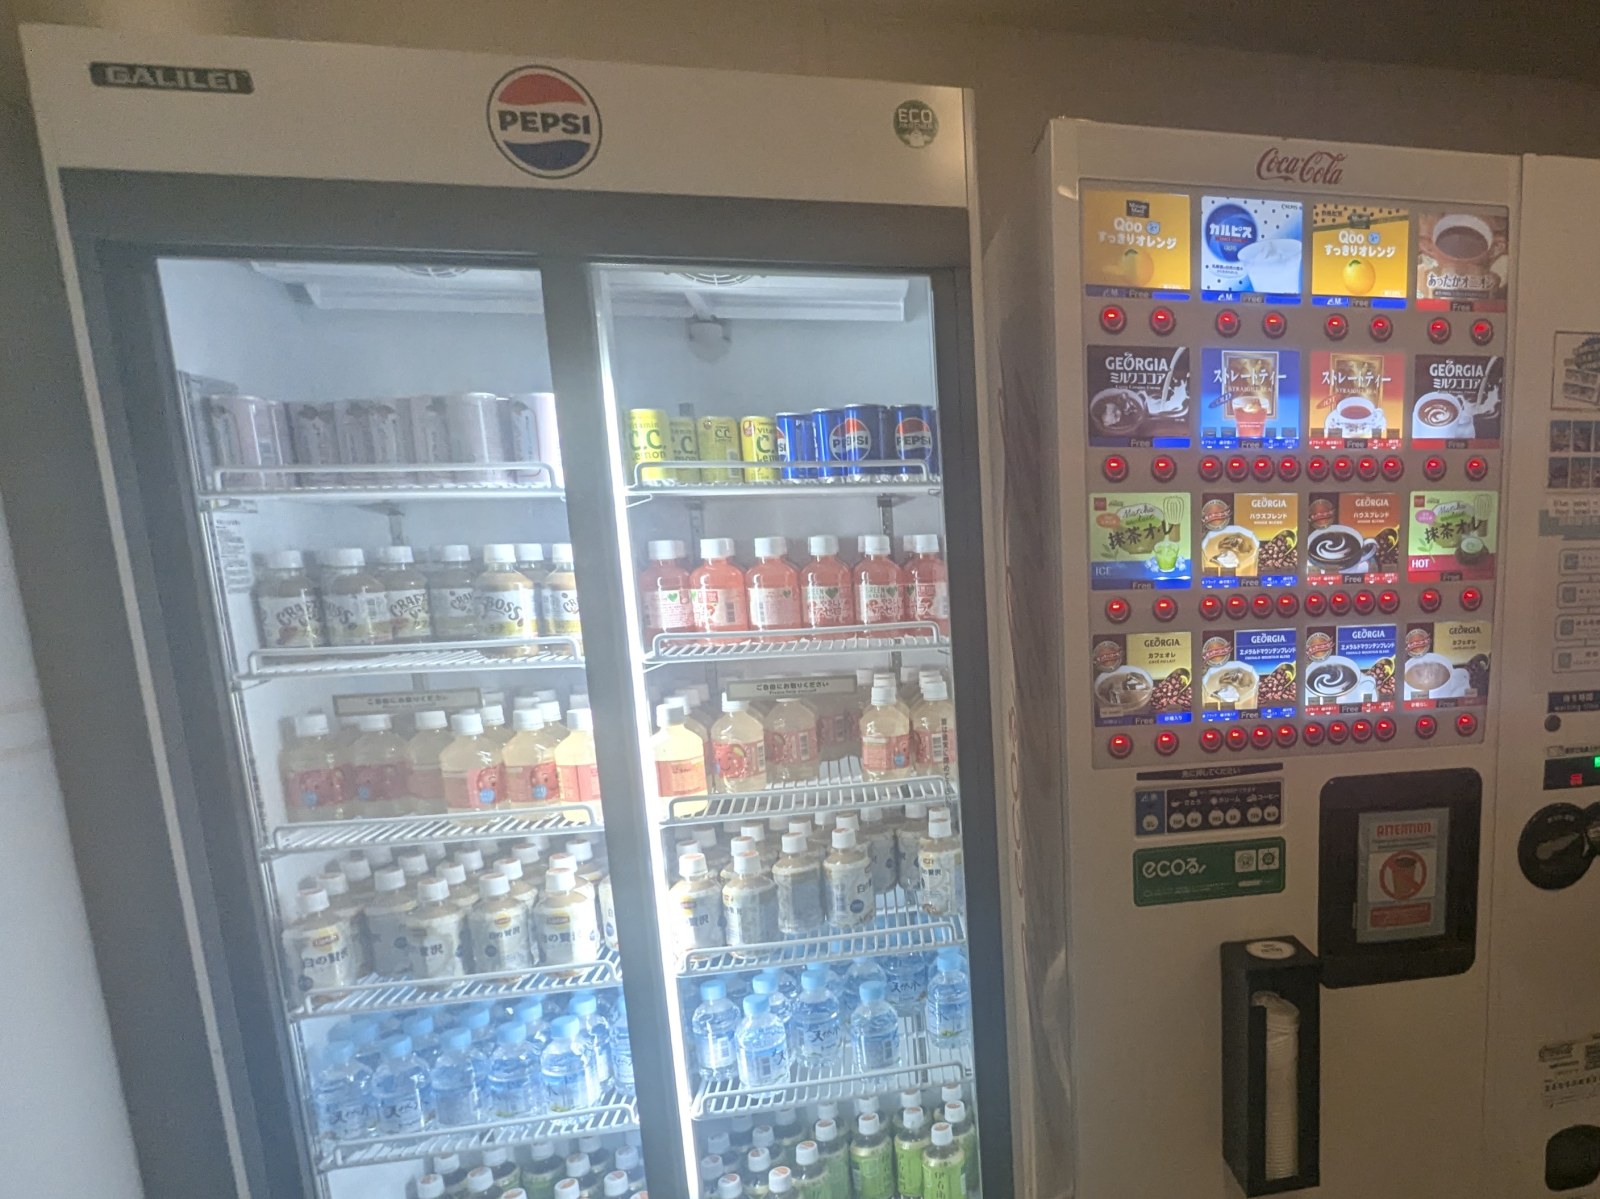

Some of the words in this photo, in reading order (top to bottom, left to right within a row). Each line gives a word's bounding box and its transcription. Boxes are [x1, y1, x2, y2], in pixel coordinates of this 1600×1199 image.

[105, 65, 239, 90] GALILEI
[898, 108, 932, 123] ECO
[498, 110, 591, 135] PEPSI
[1114, 217, 1142, 233] Qoo
[1209, 223, 1252, 239] カルピス
[1098, 231, 1177, 250] すっきりオレンジ
[1339, 231, 1364, 245] Qoo
[1324, 244, 1396, 258] すっきりオレンジ
[1129, 289, 1150, 298] Free
[1243, 295, 1263, 304] Free
[1351, 299, 1369, 307] Free
[1452, 303, 1472, 312] Free
[1105, 352, 1170, 371] GEORGIA
[1429, 359, 1484, 377] GEORGIA
[1213, 368, 1287, 386] ストレートティー
[1321, 370, 1392, 388] ストレートティー
[1131, 438, 1150, 447] Free
[1241, 441, 1260, 449] Free
[1347, 440, 1365, 448] Free
[1251, 497, 1287, 508] GEORGIA
[1355, 497, 1389, 508] GEORGIA
[1353, 511, 1390, 519] ハウスブレンド
[1411, 558, 1430, 568] HOT
[1095, 566, 1112, 577] ICE
[1241, 578, 1259, 586] Free
[1344, 575, 1362, 583] Free
[1132, 581, 1152, 590] Free
[486, 596, 522, 621] BOSS
[1251, 633, 1287, 644] GEORGIA
[1352, 629, 1386, 639] GEORGIA
[1144, 637, 1181, 648] GEORGIA
[1148, 652, 1176, 660] カフェオレ
[1342, 704, 1360, 713] Free
[1241, 711, 1259, 719] Free
[1135, 717, 1154, 726] Free
